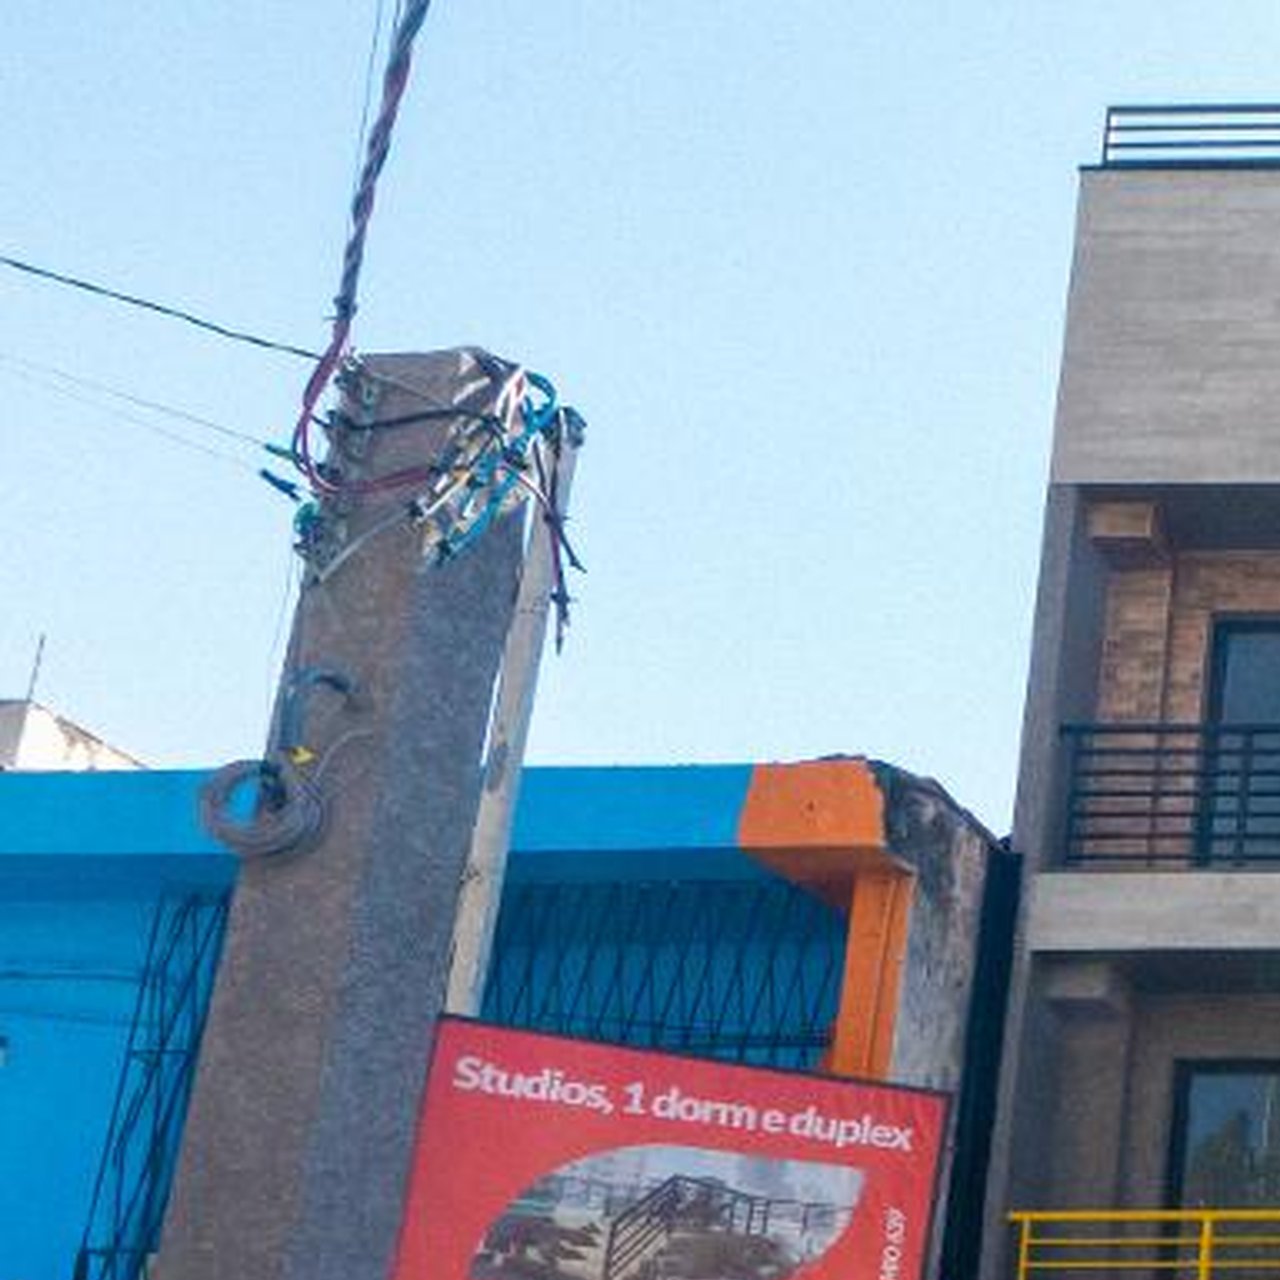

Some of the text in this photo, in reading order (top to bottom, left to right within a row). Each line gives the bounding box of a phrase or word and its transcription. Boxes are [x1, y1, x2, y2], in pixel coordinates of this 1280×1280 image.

[453, 1055, 913, 1151] Studios, 1 dorm e duplex
